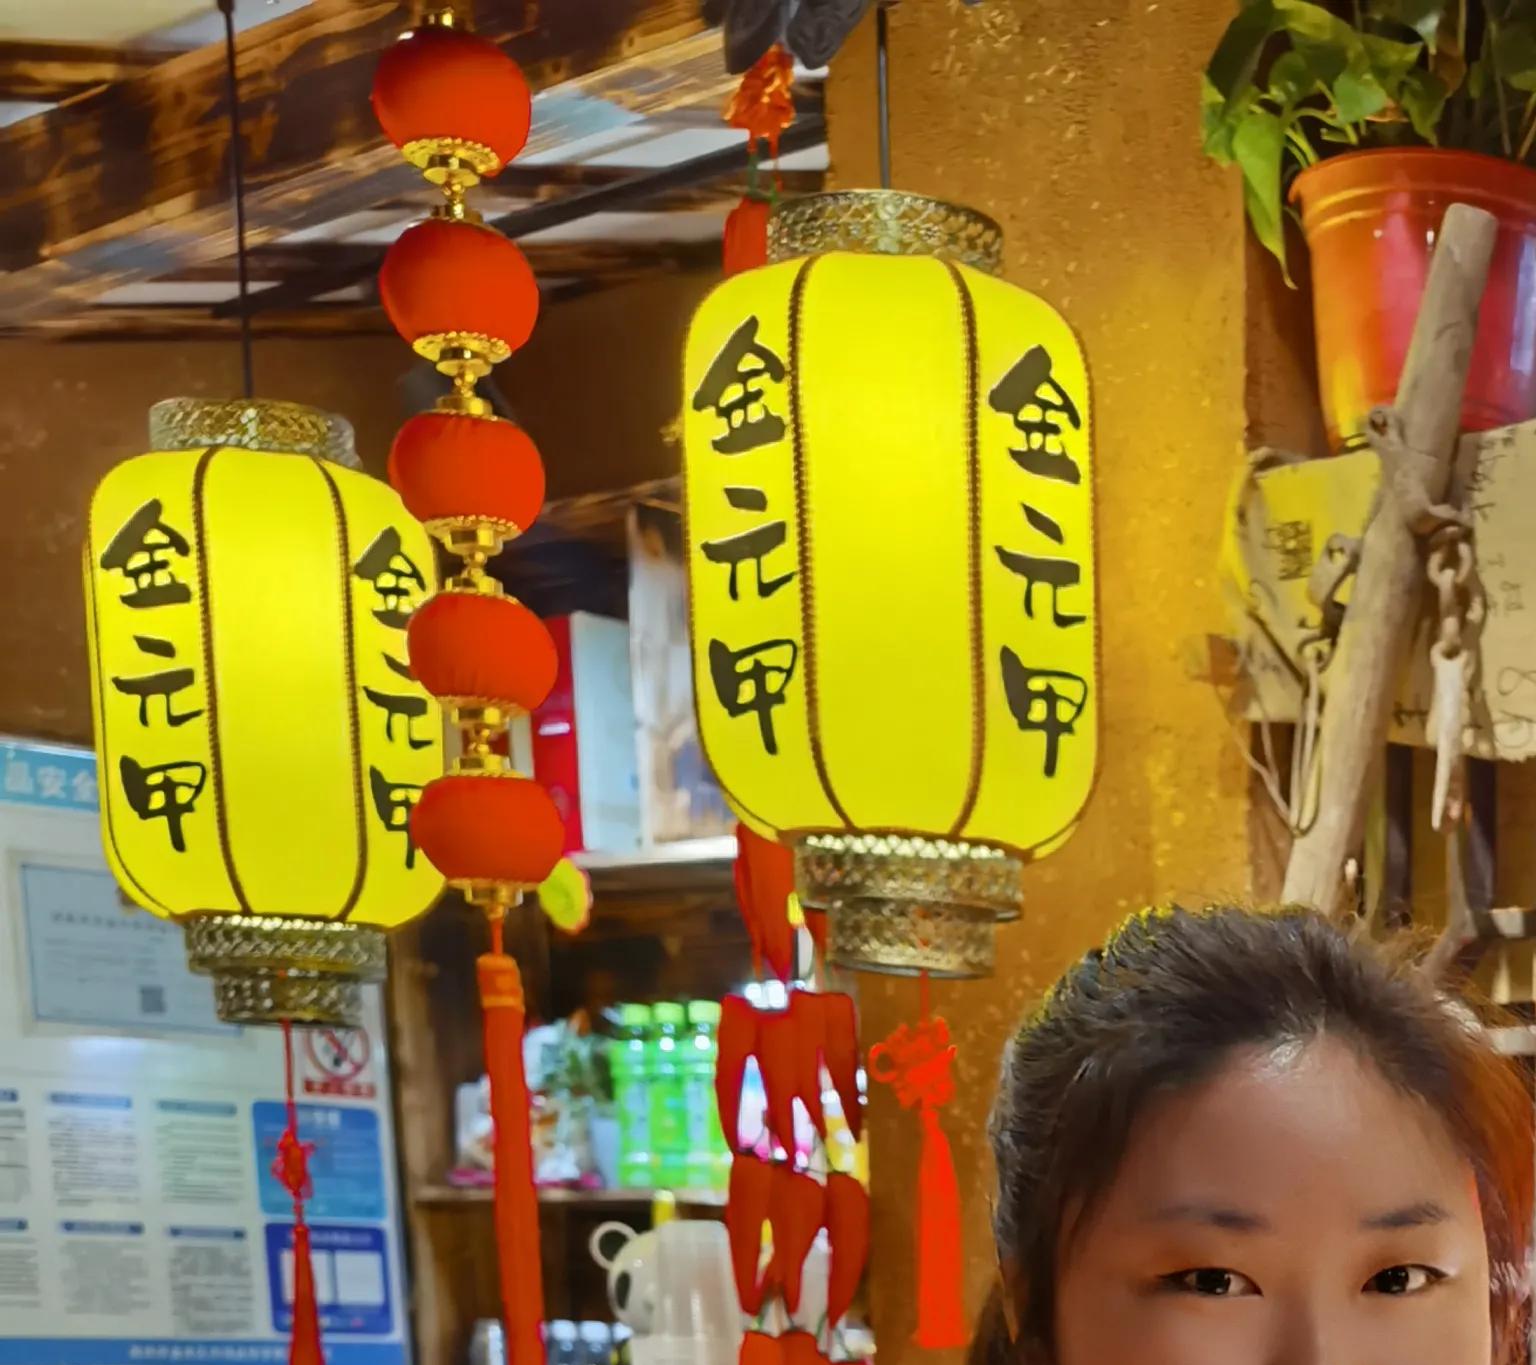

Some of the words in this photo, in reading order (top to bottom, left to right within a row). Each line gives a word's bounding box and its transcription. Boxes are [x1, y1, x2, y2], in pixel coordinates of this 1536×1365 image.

[100, 498, 206, 853] 金元甲
[692, 314, 802, 756] 金元甲
[988, 344, 1090, 778] 金元甲
